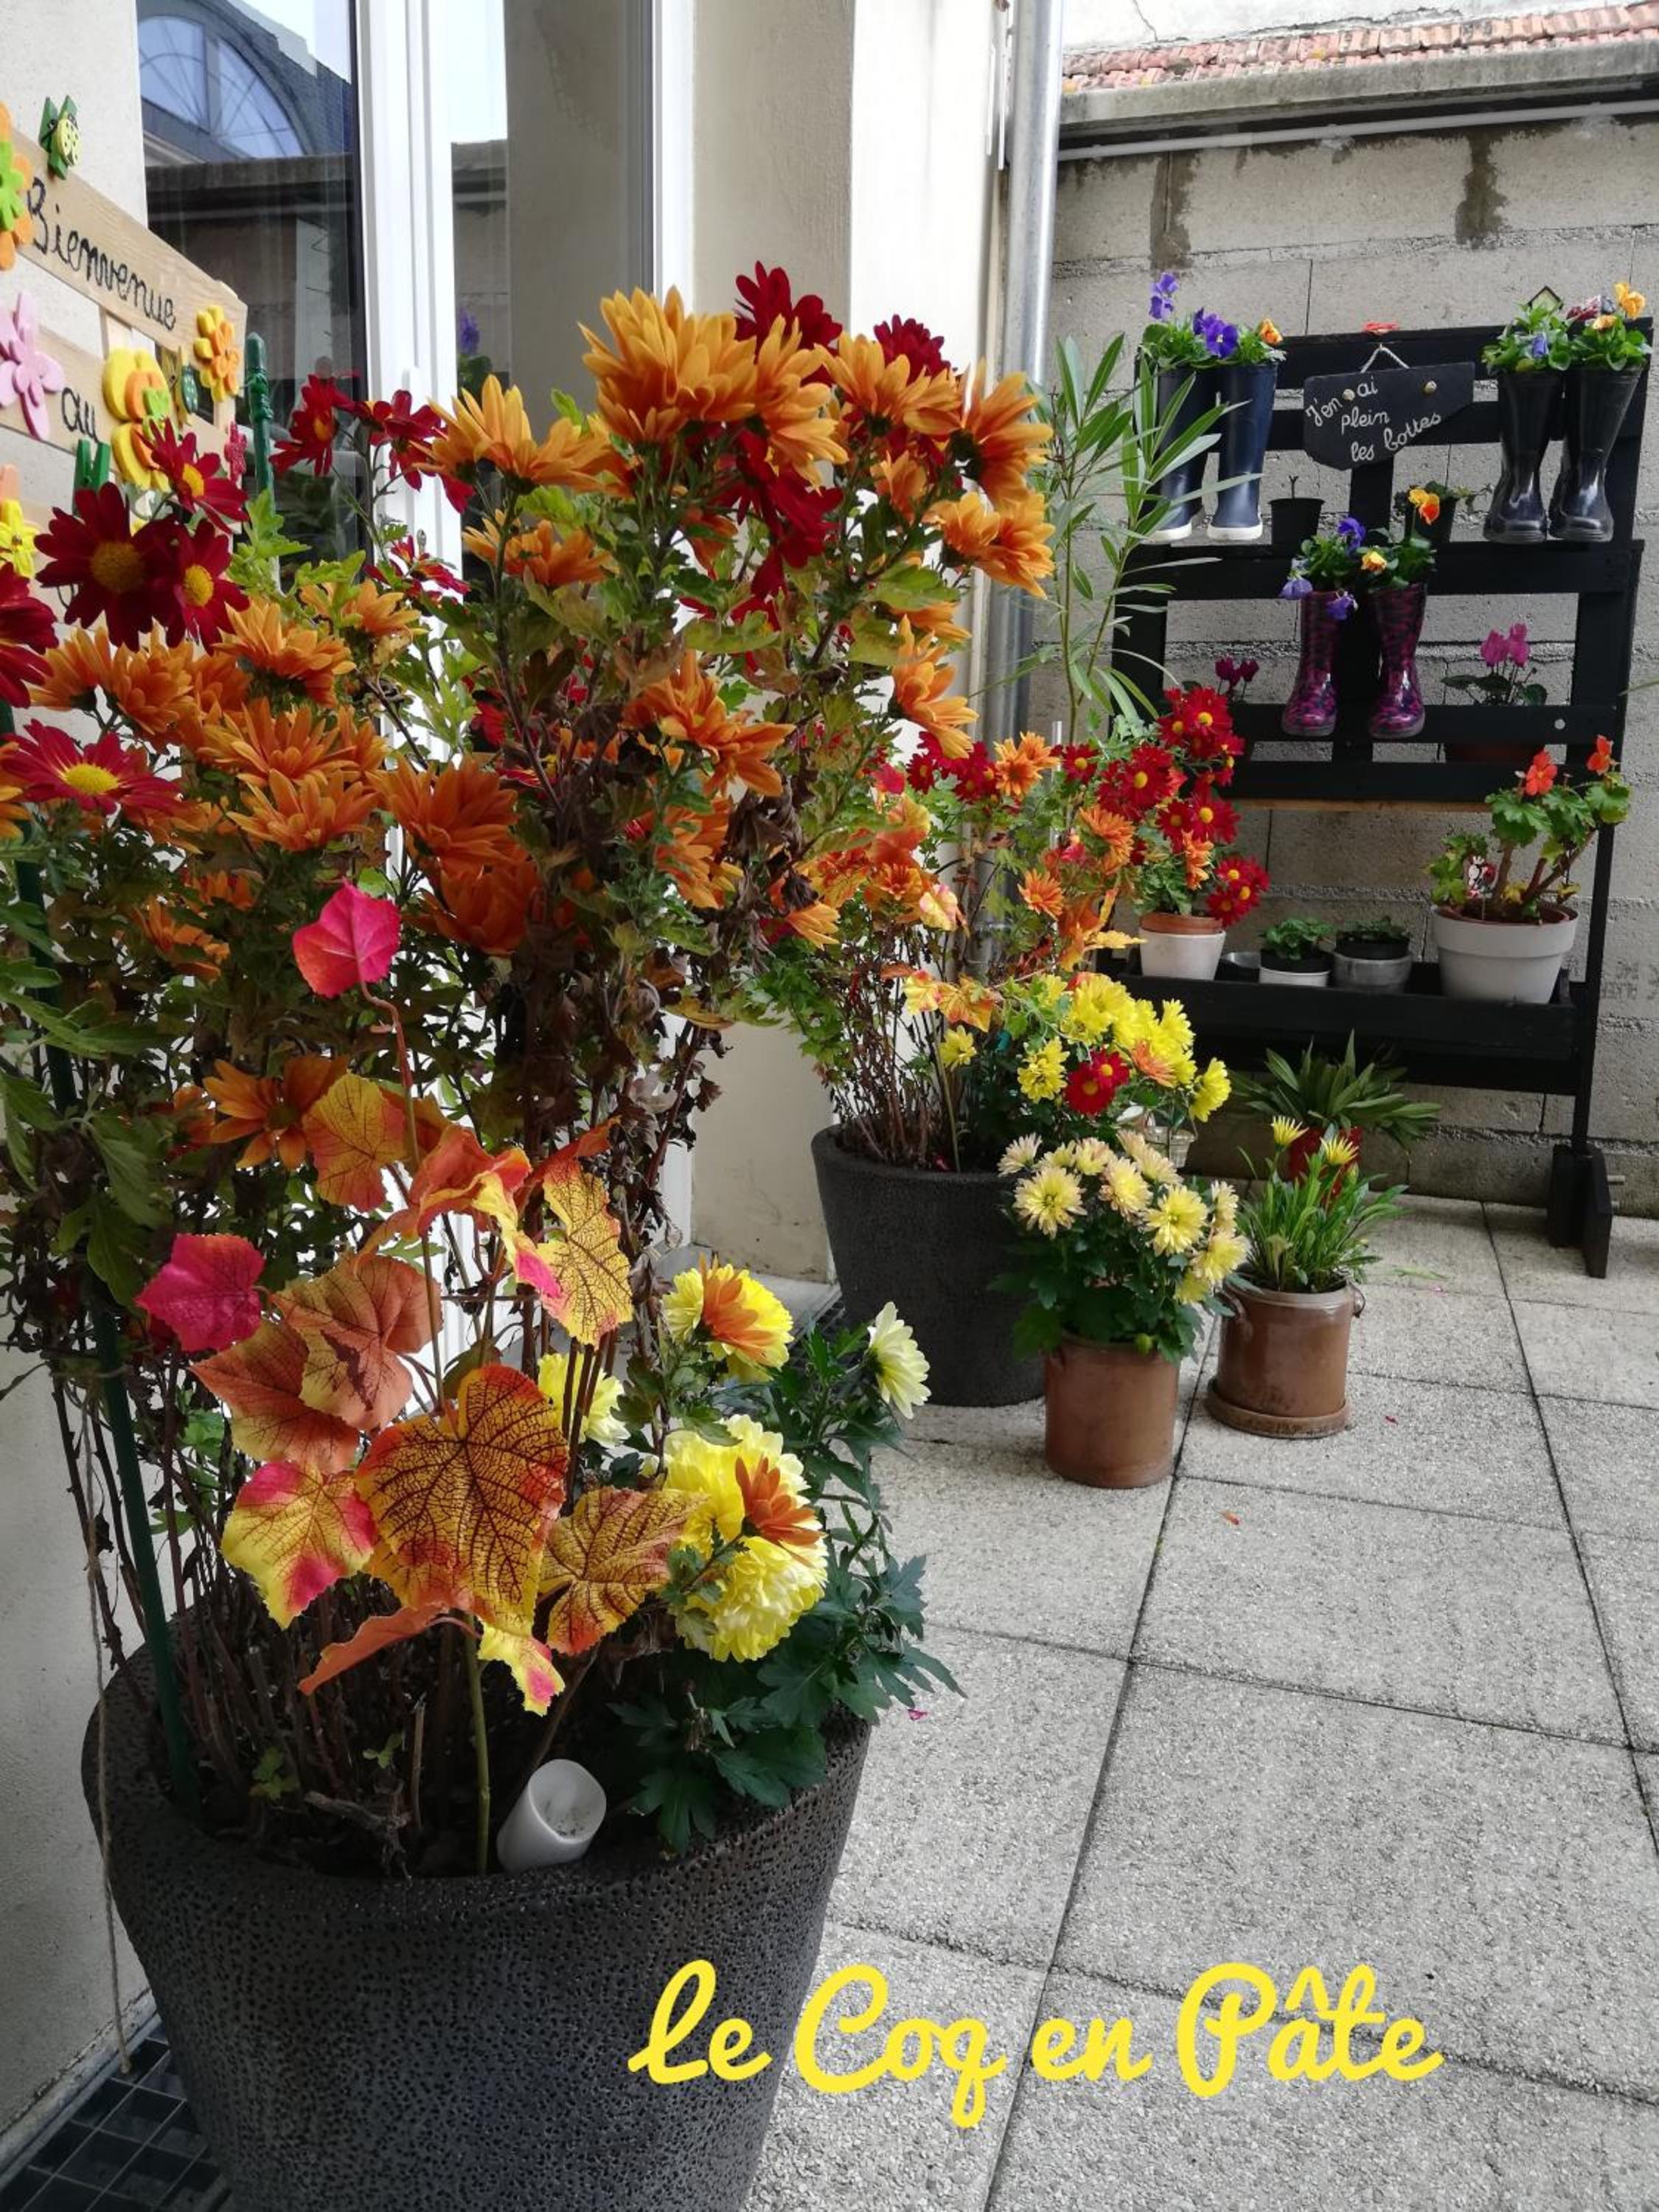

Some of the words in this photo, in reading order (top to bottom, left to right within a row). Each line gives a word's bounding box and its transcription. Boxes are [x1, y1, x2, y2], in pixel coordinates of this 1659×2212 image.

[27, 176, 177, 331] Bienvenue
[1356, 375, 1378, 398] ai
[61, 386, 99, 442] au
[1341, 407, 1390, 435] plein
[1351, 442, 1375, 462] les
[1383, 412, 1441, 451] bottes
